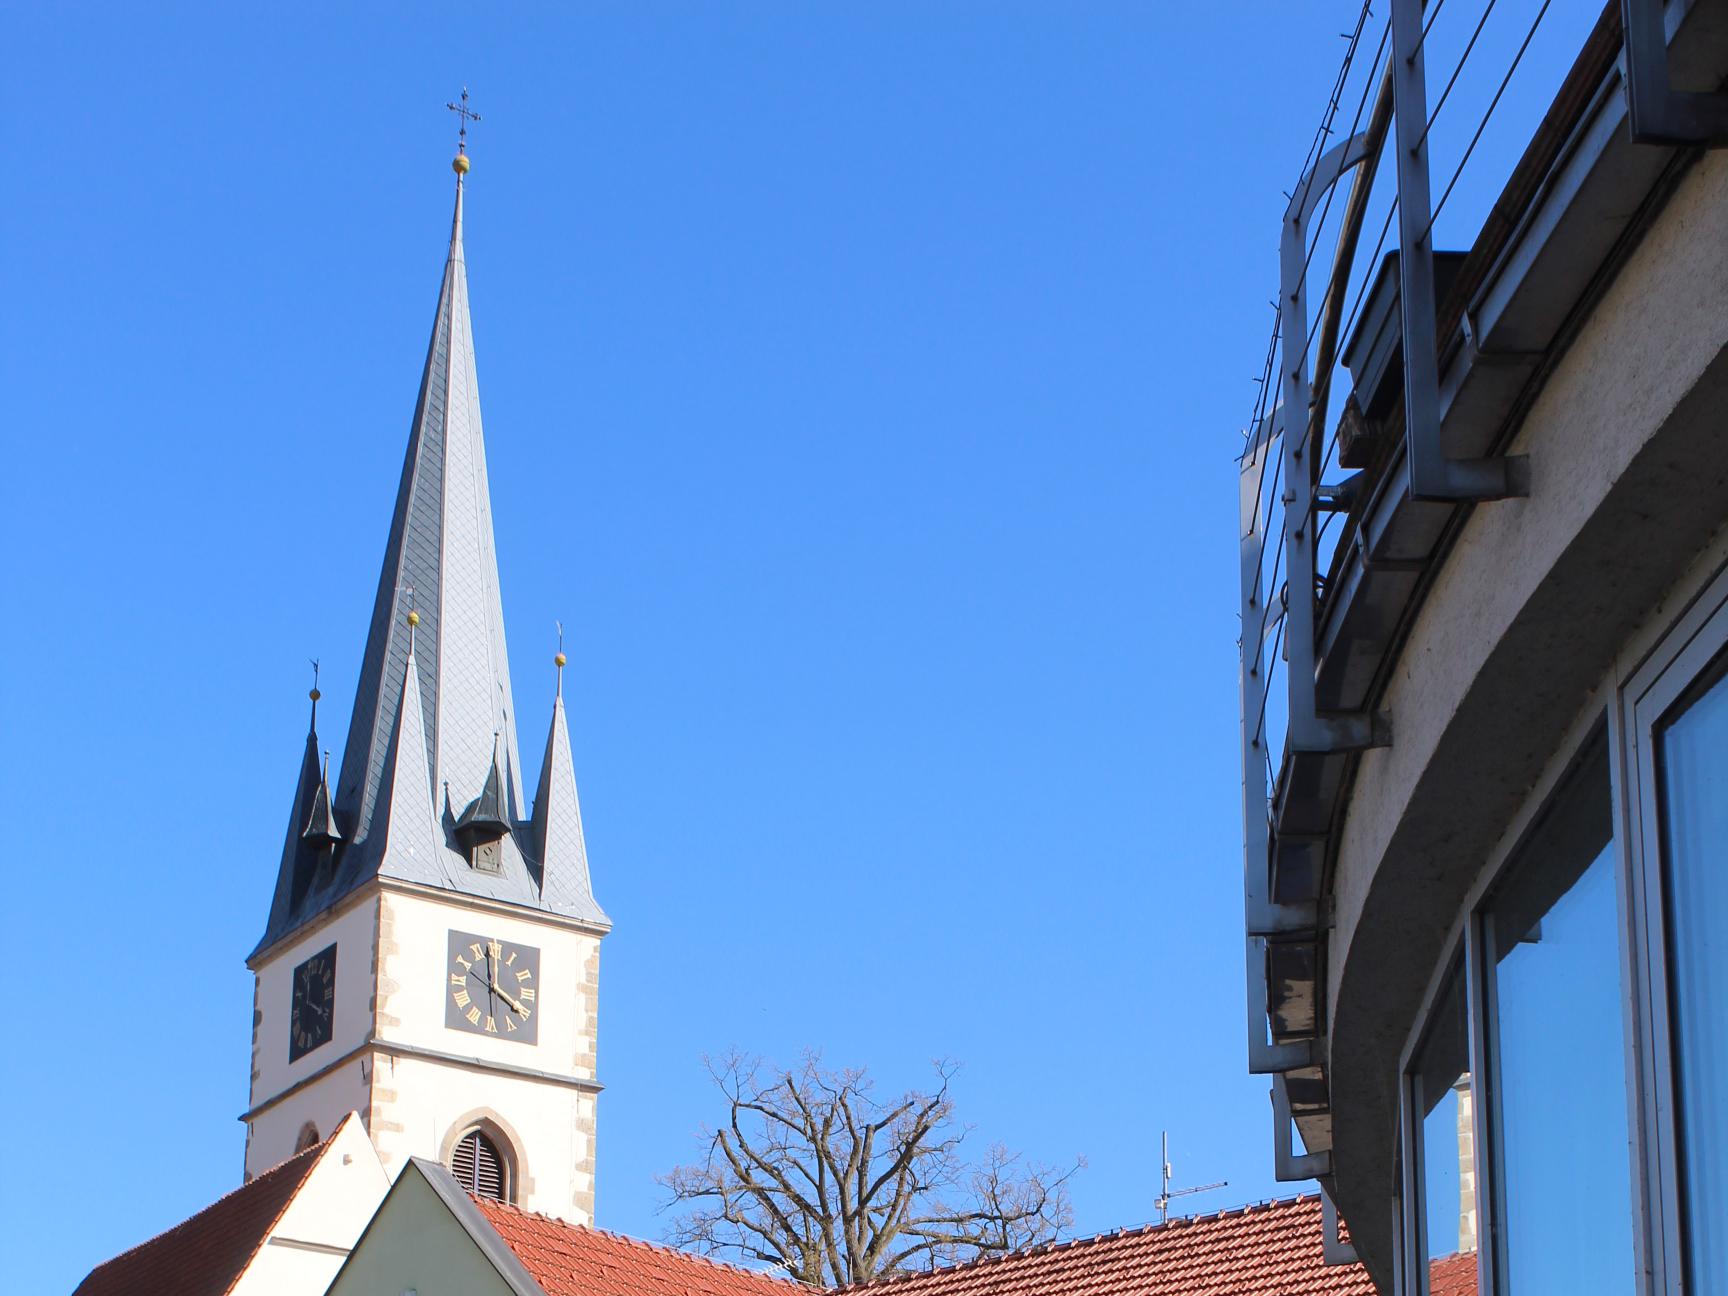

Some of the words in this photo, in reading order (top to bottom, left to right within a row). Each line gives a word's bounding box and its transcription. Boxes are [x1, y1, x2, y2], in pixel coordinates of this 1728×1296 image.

[470, 943, 486, 961] XI
[506, 951, 517, 967] I
[456, 954, 472, 971] X
[451, 973, 466, 987] IX
[516, 968, 532, 982] II
[453, 989, 471, 1010] VIII
[520, 986, 535, 1003] III
[465, 1006, 481, 1026] VII
[484, 1015, 498, 1033] VI
[505, 1015, 517, 1032] V
